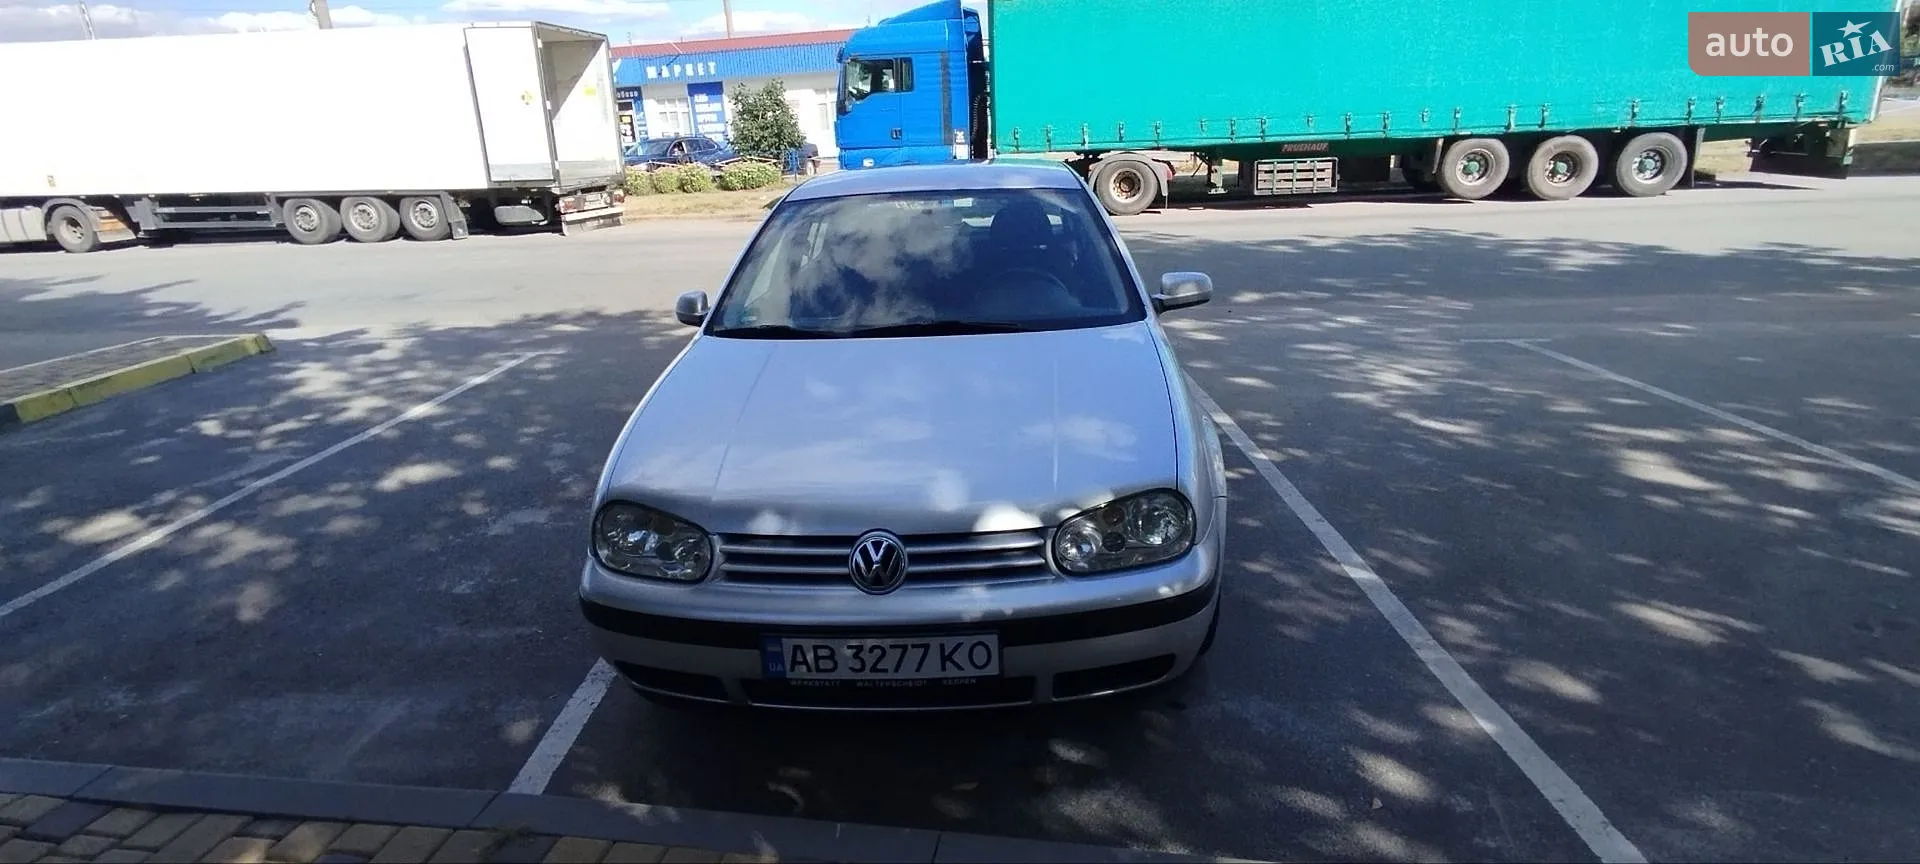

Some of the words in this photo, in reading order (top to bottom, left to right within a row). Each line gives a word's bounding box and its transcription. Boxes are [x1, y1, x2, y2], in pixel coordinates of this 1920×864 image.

[853, 536, 904, 591] VW
[769, 663, 784, 672] UA
[789, 644, 838, 673] AB
[846, 643, 930, 673] 3277
[939, 640, 993, 672] KO
